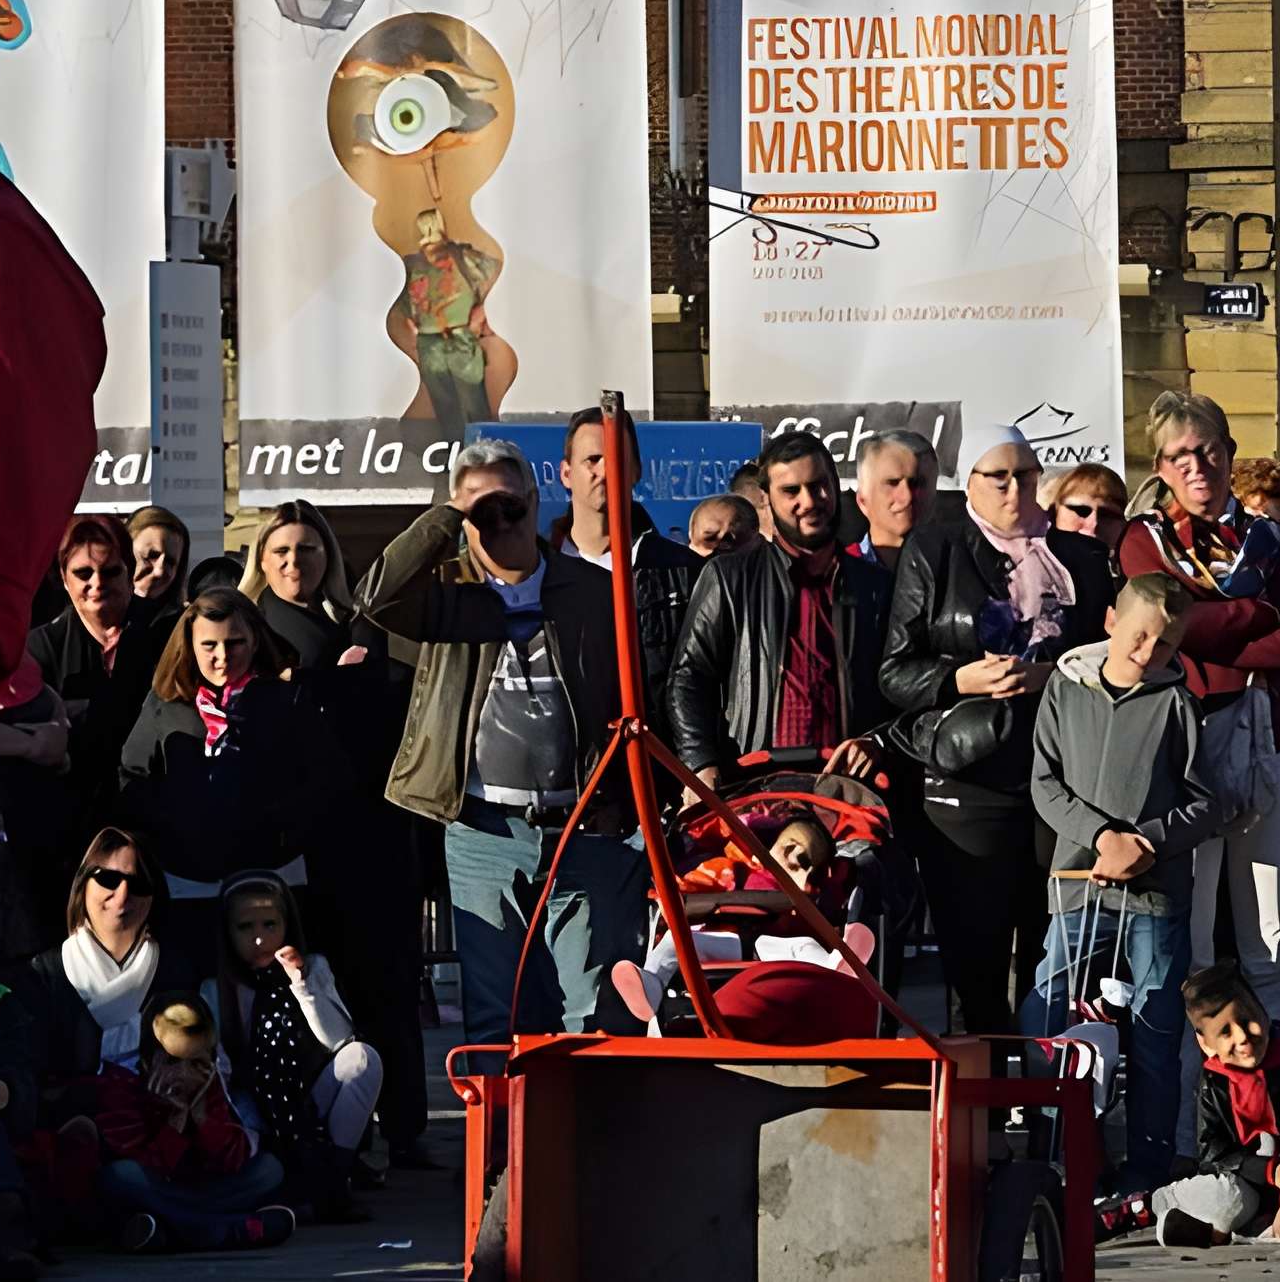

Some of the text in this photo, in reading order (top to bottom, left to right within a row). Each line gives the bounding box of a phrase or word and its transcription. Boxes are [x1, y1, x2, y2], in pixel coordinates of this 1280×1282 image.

[747, 14, 1068, 61] FESTIVAL MONDIAL
[747, 67, 819, 114] DES
[1022, 61, 1068, 110] DE
[747, 117, 1070, 174] MARIONNETTES
[246, 438, 344, 476] met
[359, 429, 404, 475] la
